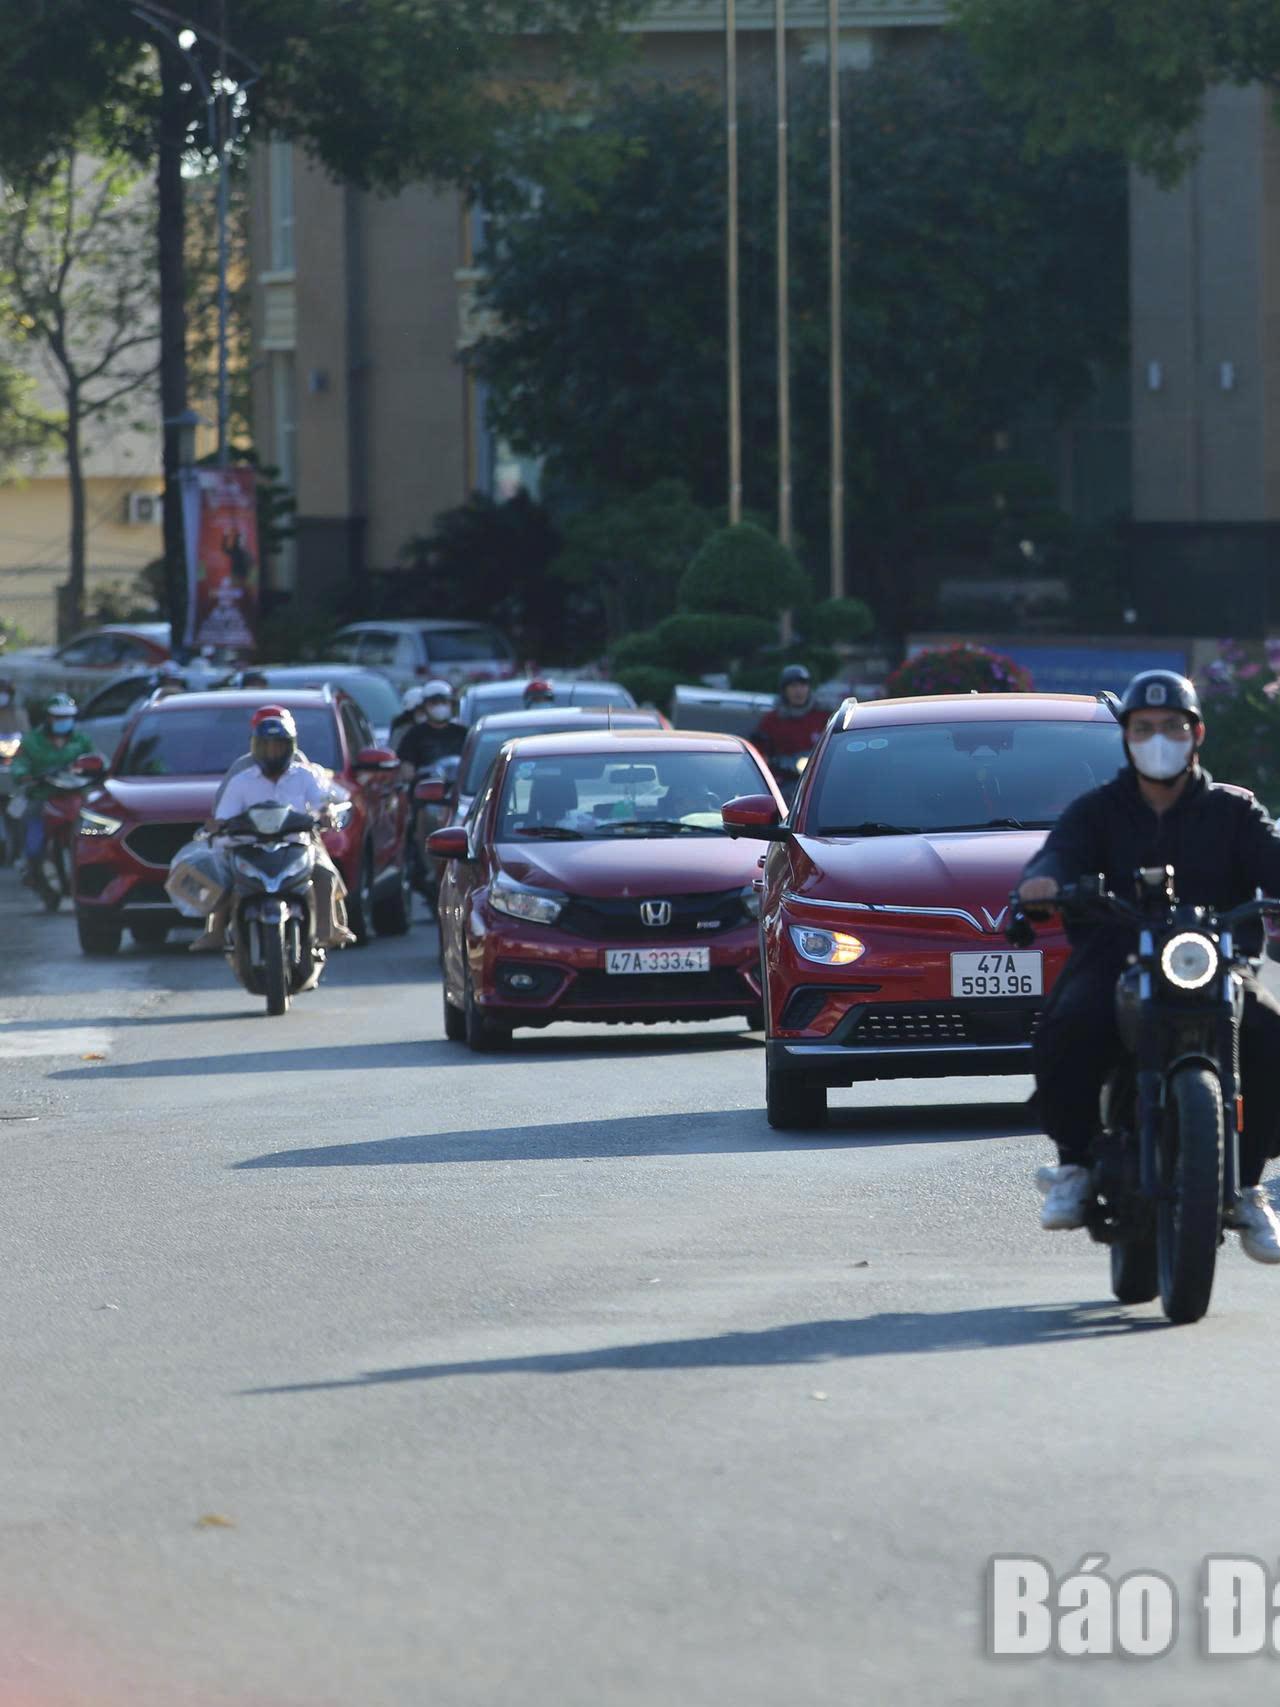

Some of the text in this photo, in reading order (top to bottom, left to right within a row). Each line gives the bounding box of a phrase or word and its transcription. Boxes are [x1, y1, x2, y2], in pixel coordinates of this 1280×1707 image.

[610, 951, 704, 972] 47A-333.41
[978, 955, 1016, 974] 47A
[961, 975, 1033, 995] 593.96
